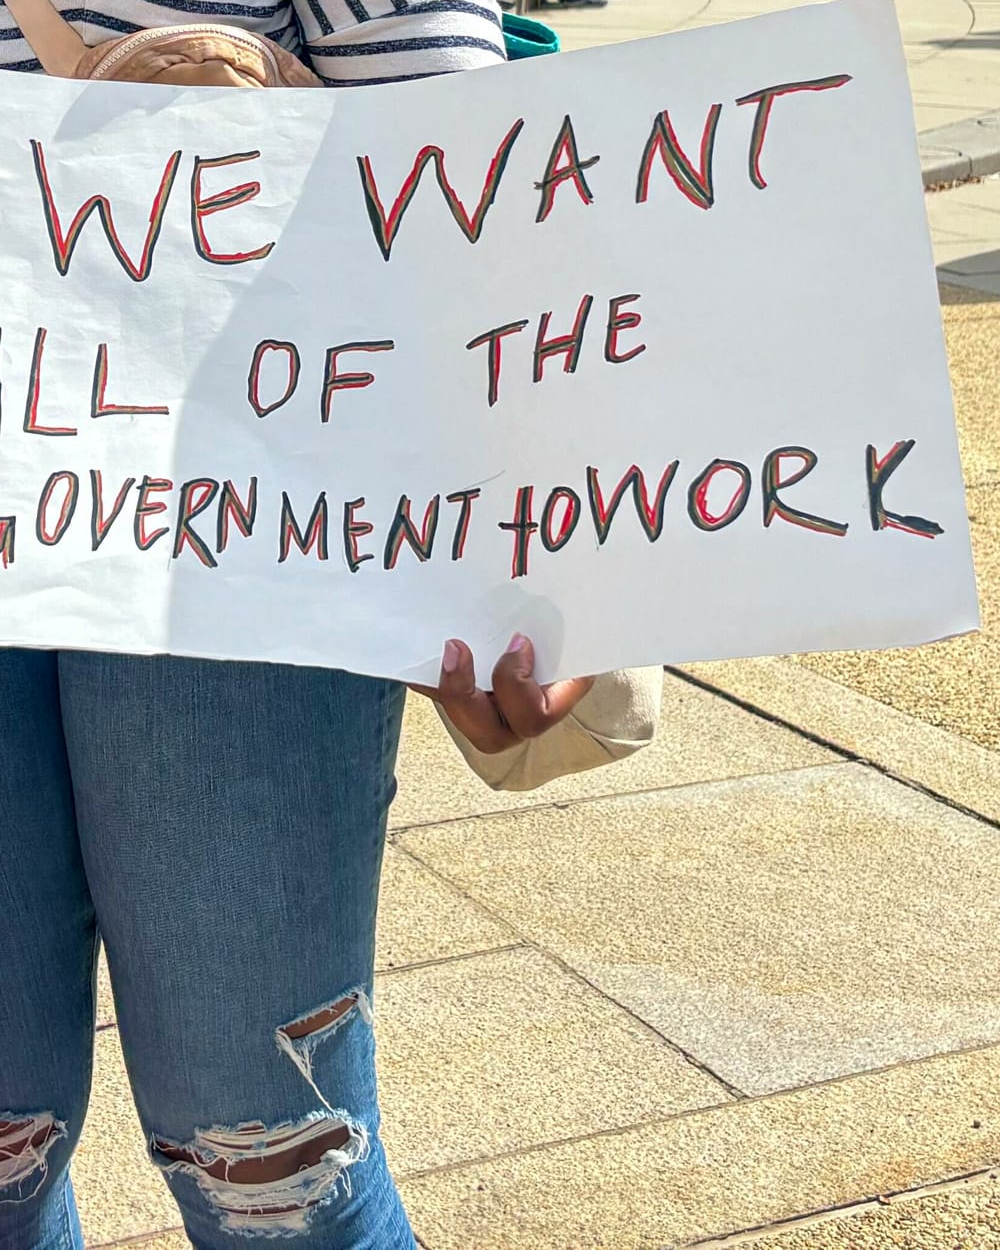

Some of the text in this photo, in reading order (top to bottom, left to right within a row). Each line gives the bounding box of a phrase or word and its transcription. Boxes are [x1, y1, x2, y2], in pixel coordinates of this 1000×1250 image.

[29, 74, 852, 281] WE WANT
[247, 338, 394, 423] OF
[467, 293, 648, 408] THE
[584, 439, 946, 550] WORK
